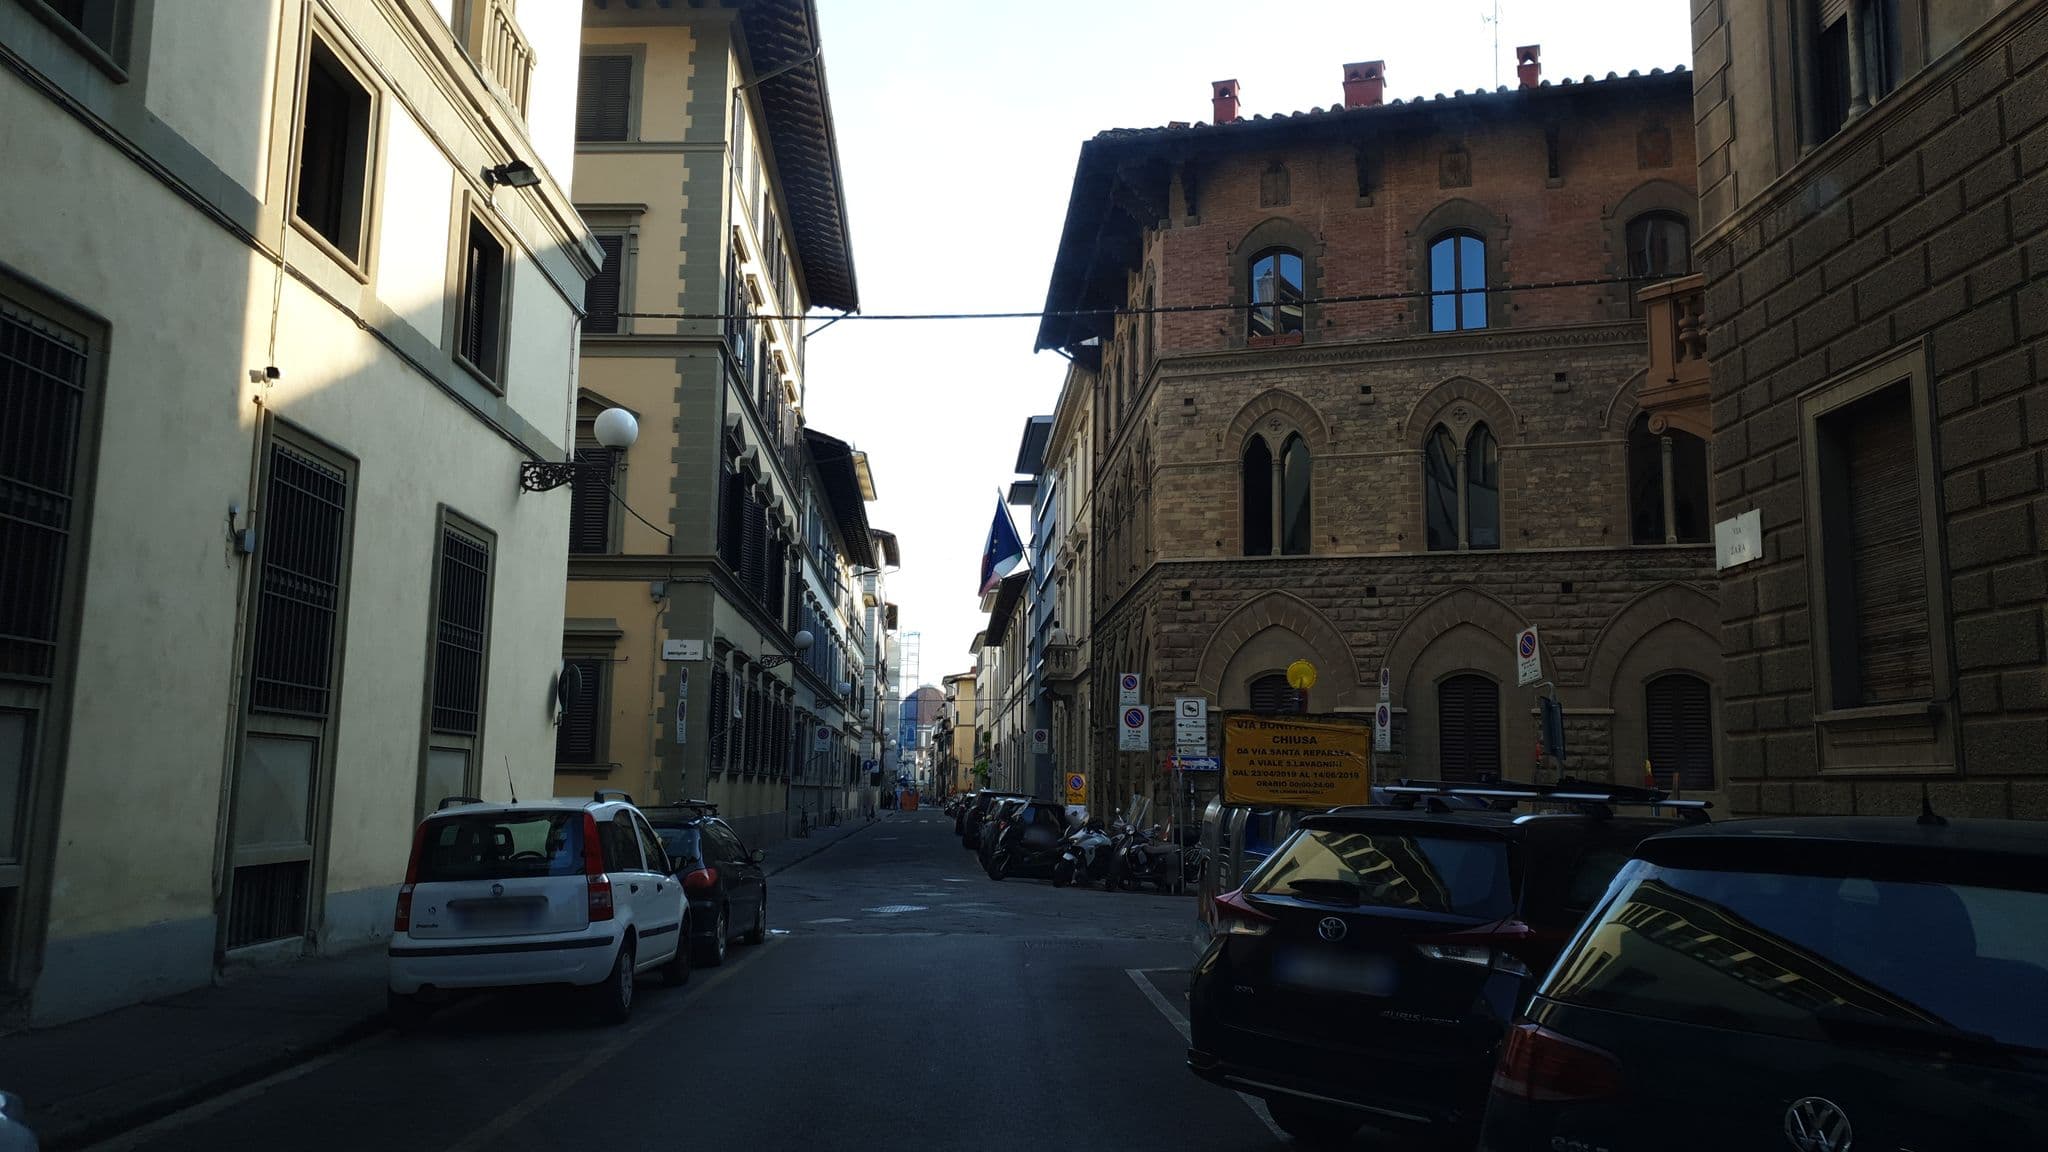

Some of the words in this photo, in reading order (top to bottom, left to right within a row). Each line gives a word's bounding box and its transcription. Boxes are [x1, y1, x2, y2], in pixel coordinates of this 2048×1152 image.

[1237, 721, 1257, 729] VIA
[1272, 735, 1317, 744] CHIUSA
[1251, 748, 1267, 756] VIA
[1269, 749, 1301, 757] SANTA
[1248, 759, 1255, 767] A
[1258, 759, 1284, 767] VIALE
[1232, 769, 1249, 777] DAL
[1299, 771, 1311, 779] AL
